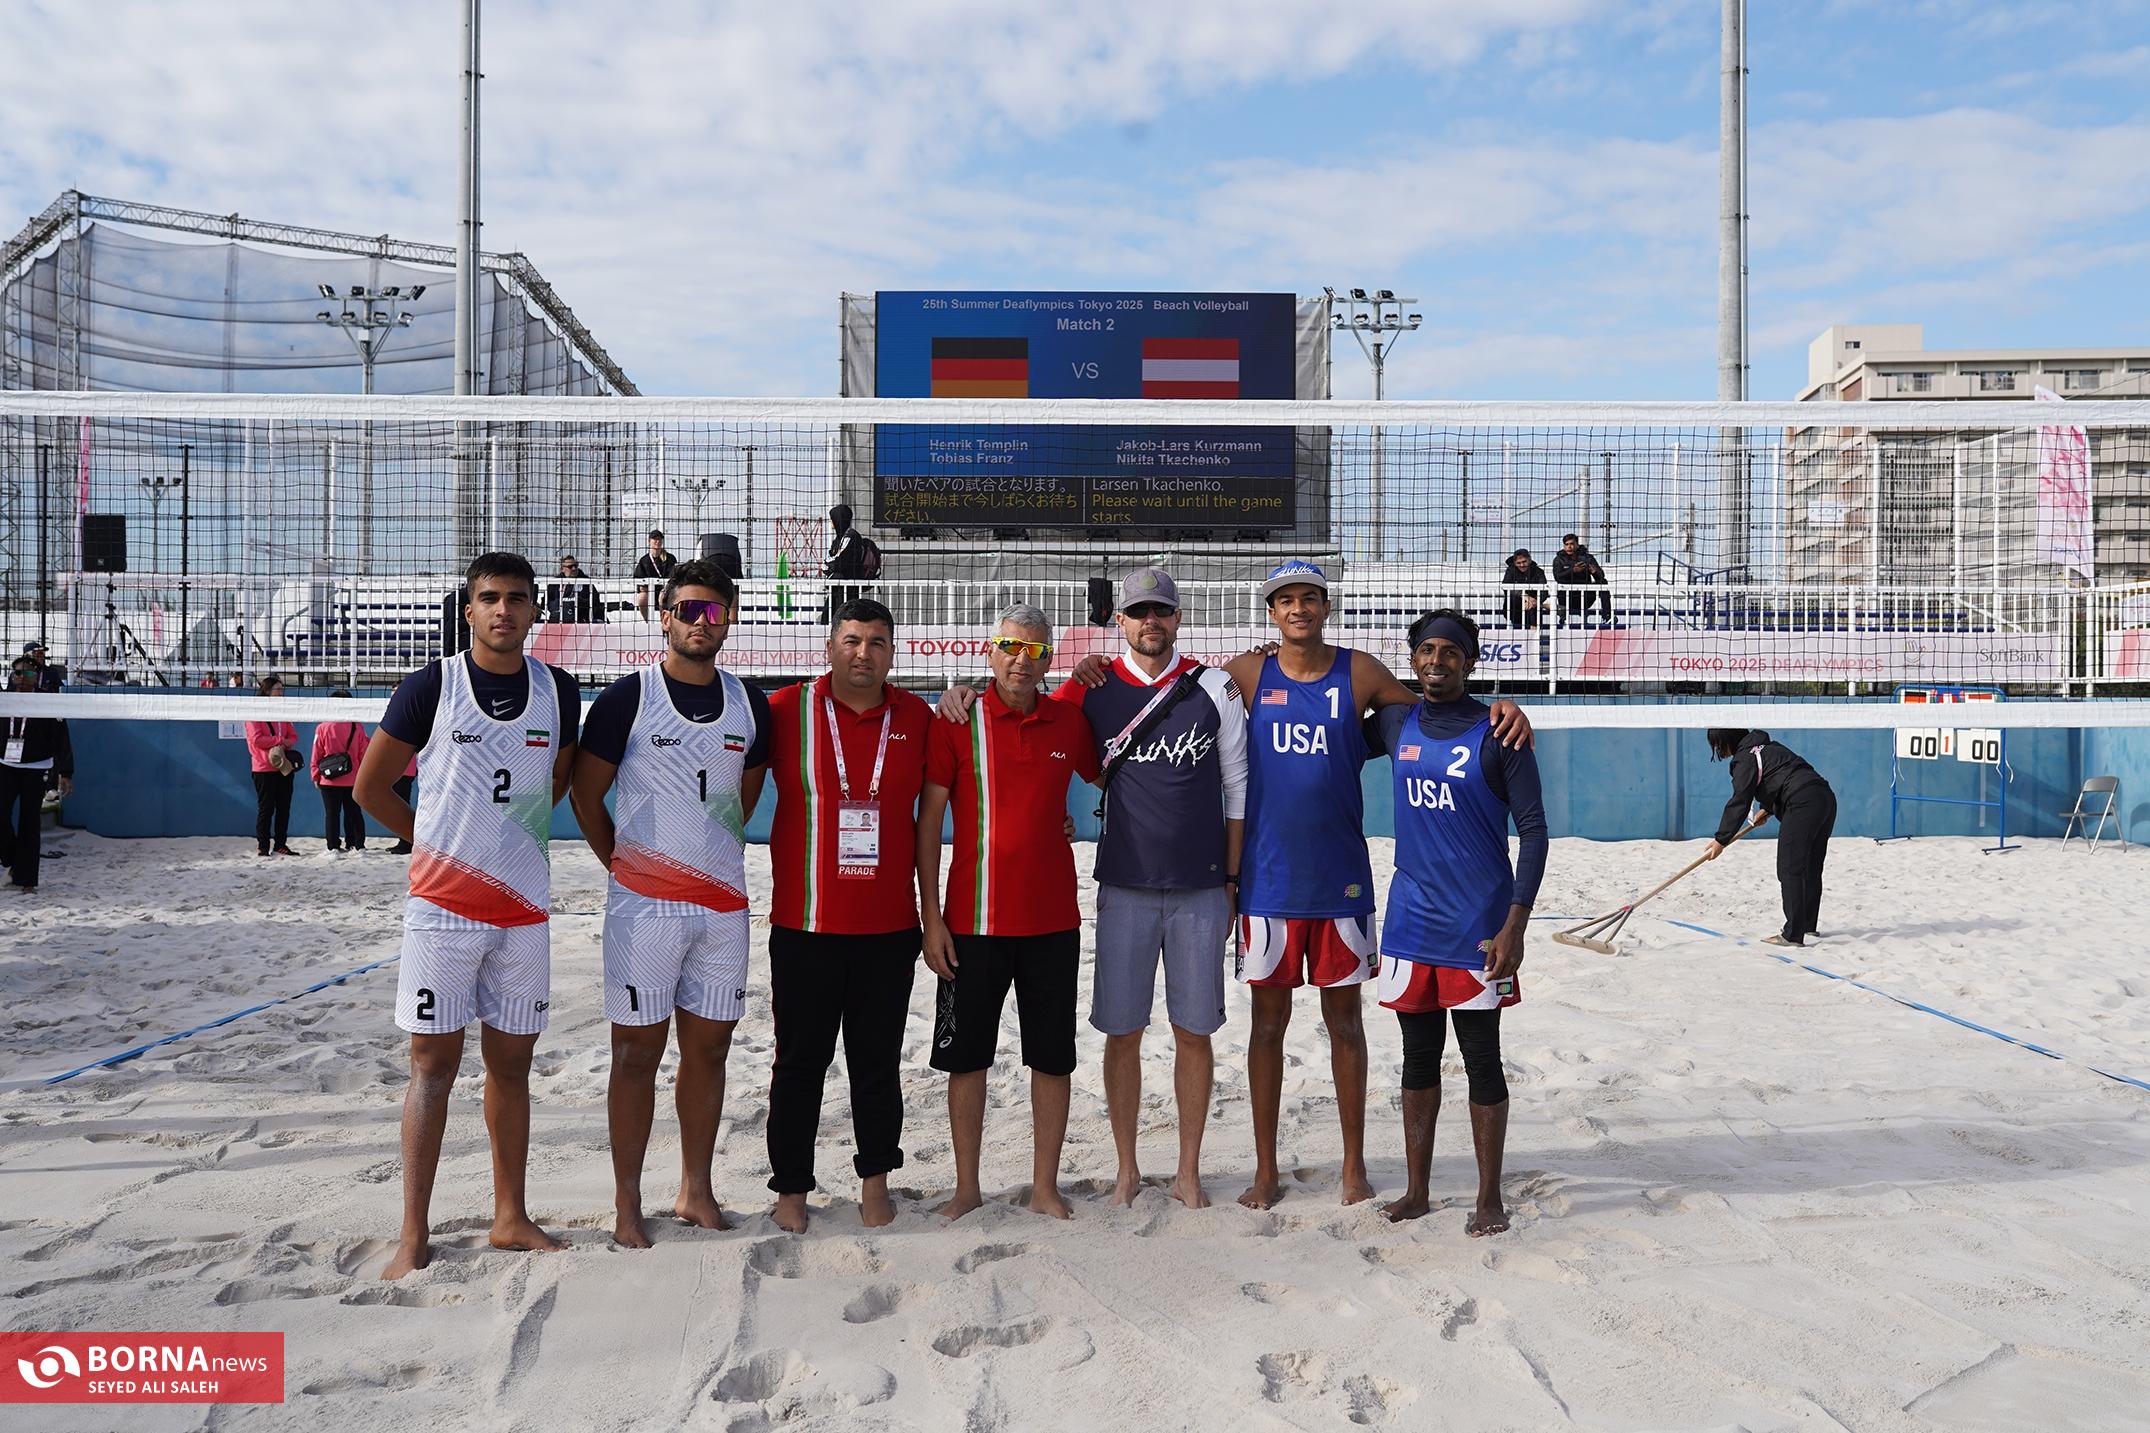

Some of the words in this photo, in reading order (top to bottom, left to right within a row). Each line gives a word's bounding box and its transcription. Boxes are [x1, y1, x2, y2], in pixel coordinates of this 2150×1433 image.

[923, 299, 947, 310] 25th
[951, 299, 1000, 310] Summer
[1003, 299, 1074, 312] Deaflympics
[1078, 300, 1113, 312] Tokyo
[1116, 300, 1144, 310] 2025
[1153, 300, 1190, 310] Beach
[1193, 300, 1249, 313] Volleyball
[1056, 318, 1101, 331] Match
[1106, 318, 1115, 331] 2
[1071, 362, 1099, 379] VS
[929, 439, 972, 450] Henrik
[976, 439, 1028, 452] Templin
[1116, 440, 1190, 451] Jakob-Lars
[1195, 440, 1262, 451] Kurzmann
[929, 453, 972, 464] Tobias
[976, 453, 1014, 464] Franz
[1116, 454, 1154, 465] Nikita
[1158, 454, 1231, 466] Tkachenko
[1092, 479, 1139, 491] Larsen
[1143, 478, 1225, 491] Tkachenko.
[1092, 494, 1138, 507] Please
[1142, 495, 1172, 507] wait
[1176, 494, 1209, 508] until
[1213, 494, 1237, 508] the
[1241, 497, 1282, 512] game
[717, 651, 829, 665] DEAFLYMPICS
[1979, 648, 2045, 663] SoftBank
[1669, 657, 1724, 672] TOKYO
[1729, 658, 1767, 672] 2025
[1772, 658, 1884, 672] DEAFLYMPICS
[1324, 687, 1339, 719] 1
[1272, 722, 1329, 755] USA
[1910, 736, 1937, 757] 00
[1944, 736, 1950, 752] 1
[1972, 740, 1999, 761] 00
[1446, 745, 1471, 779] 2
[493, 768, 511, 803] 2
[696, 769, 707, 802] 1
[1406, 777, 1456, 812] USA
[838, 866, 876, 876] PARADE
[417, 988, 435, 1020] 2
[625, 984, 639, 1012] 1
